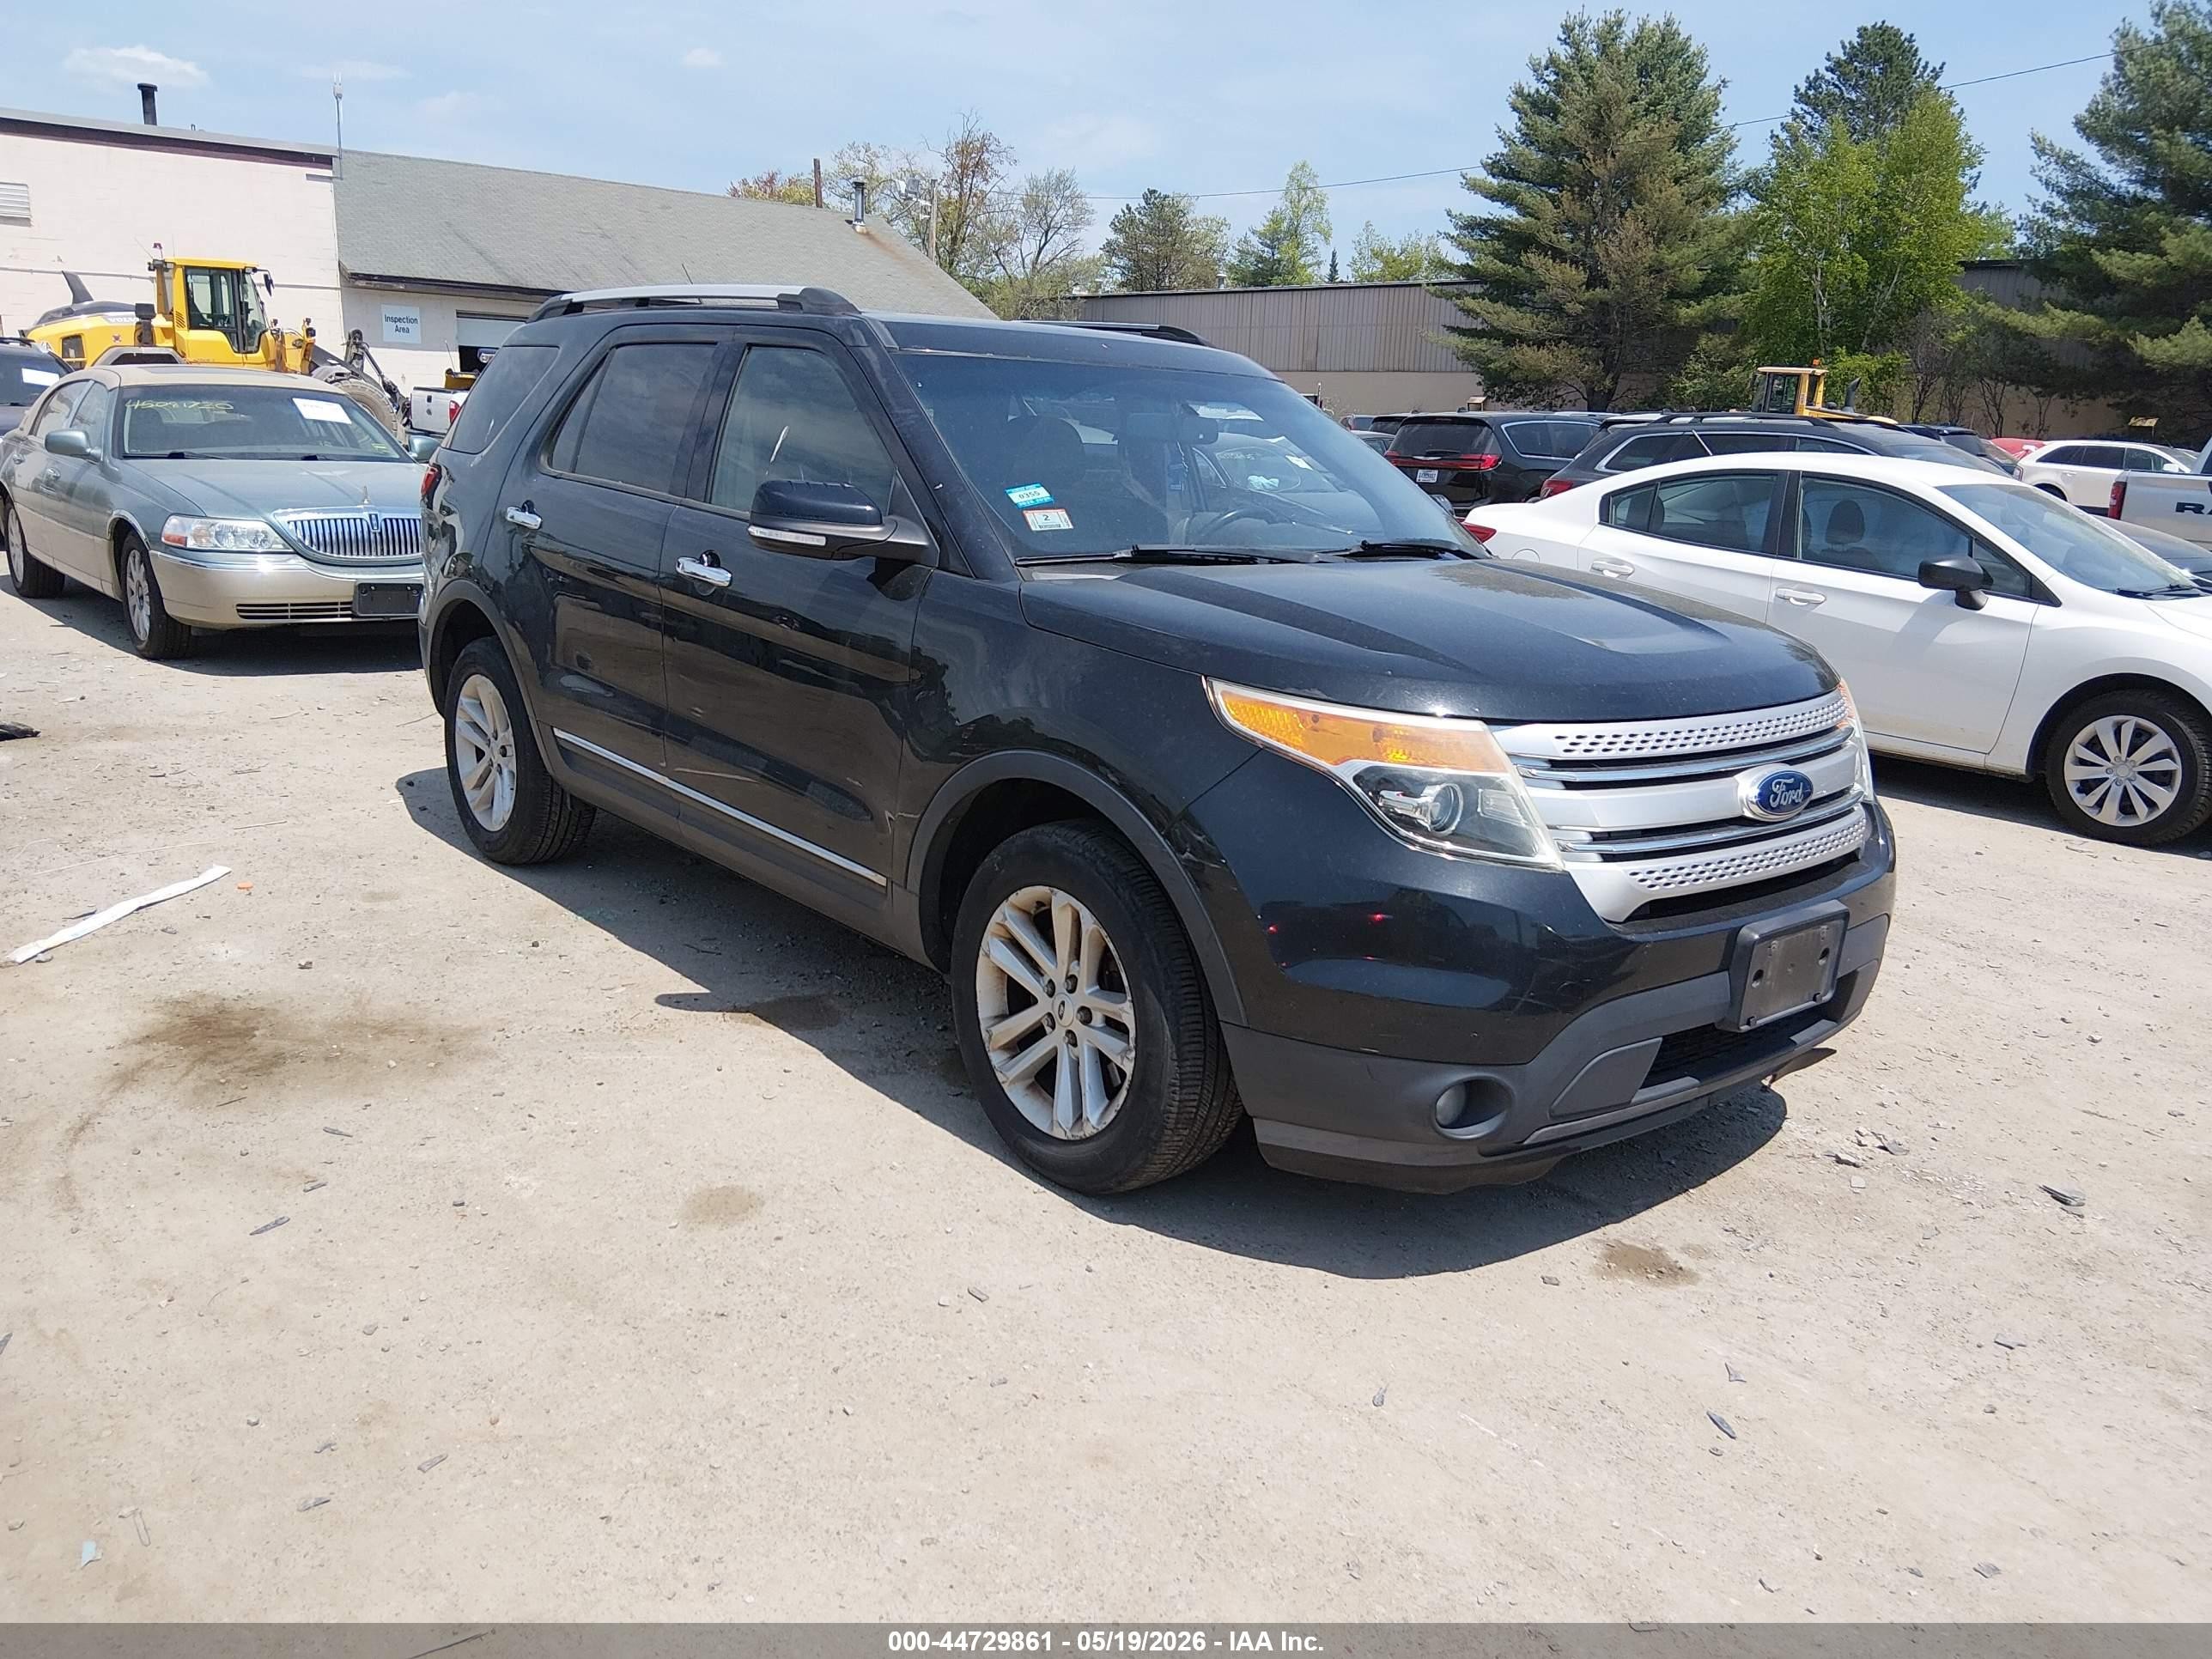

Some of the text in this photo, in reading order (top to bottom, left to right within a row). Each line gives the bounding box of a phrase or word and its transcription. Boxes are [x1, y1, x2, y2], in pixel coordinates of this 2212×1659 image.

[384, 314, 419, 325] Inspection
[395, 325, 410, 334] Area
[2175, 501, 2212, 515] R
[1770, 778, 1804, 808] Ford
